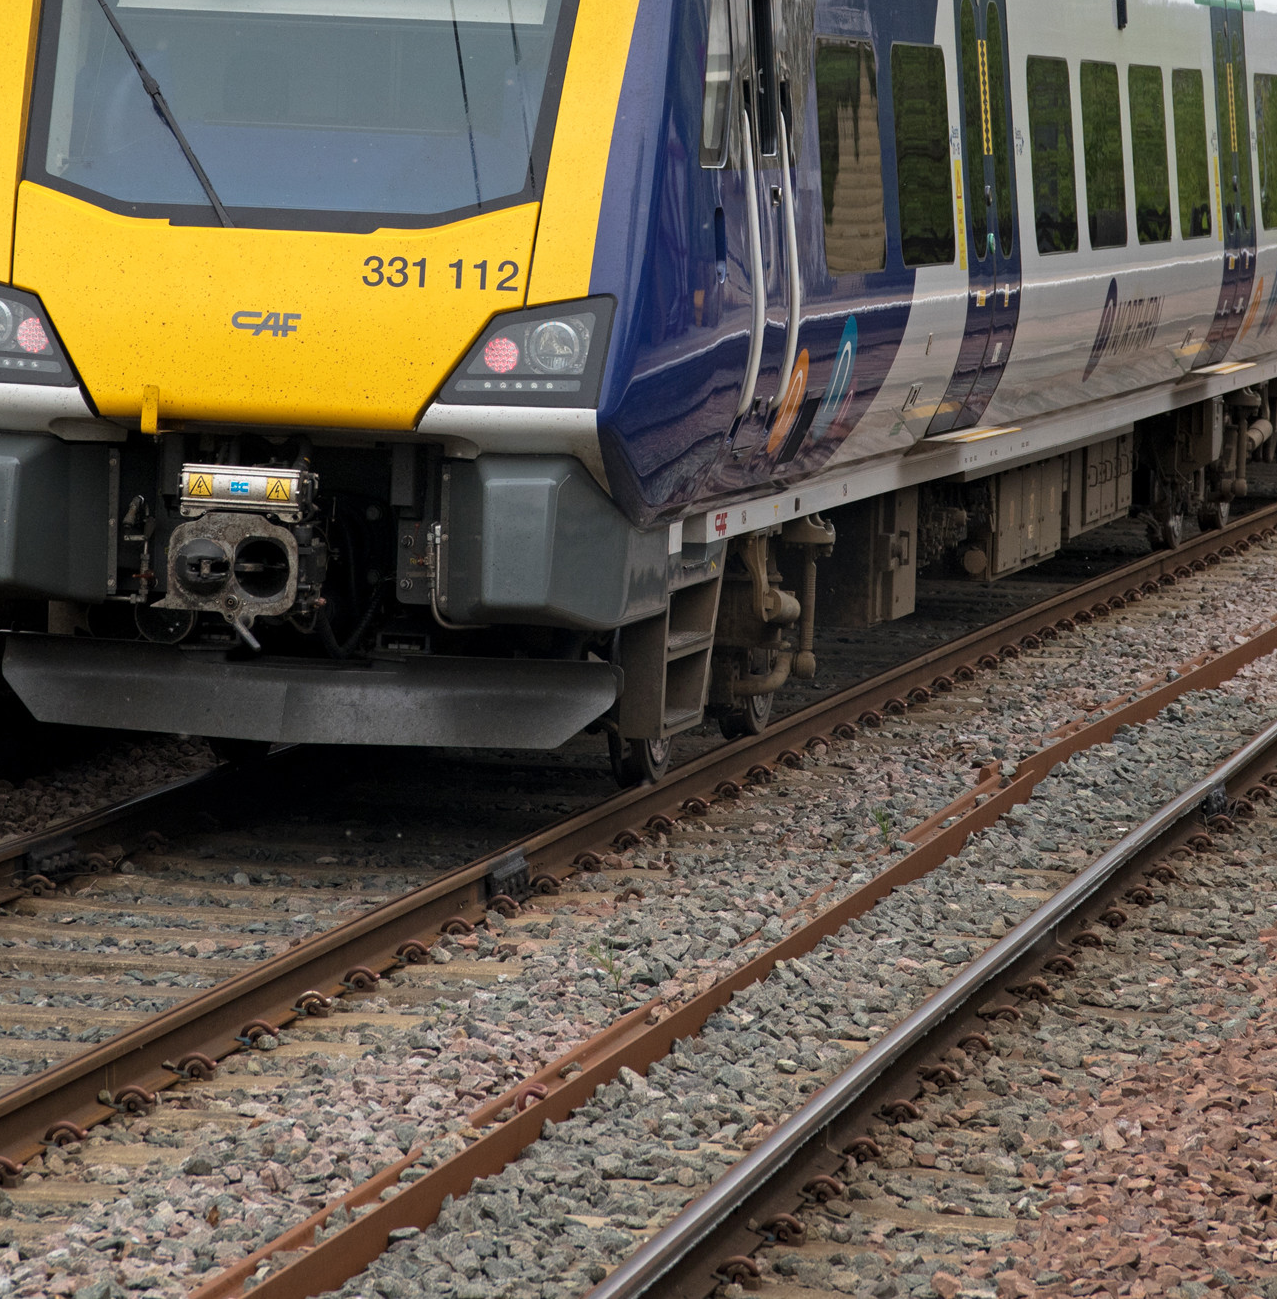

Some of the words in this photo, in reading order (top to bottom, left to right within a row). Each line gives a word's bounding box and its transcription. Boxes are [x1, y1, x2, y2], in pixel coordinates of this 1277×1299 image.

[362, 256, 427, 288] 331
[449, 259, 520, 292] 112
[231, 310, 302, 338] CAF
[715, 512, 728, 537] CAF
